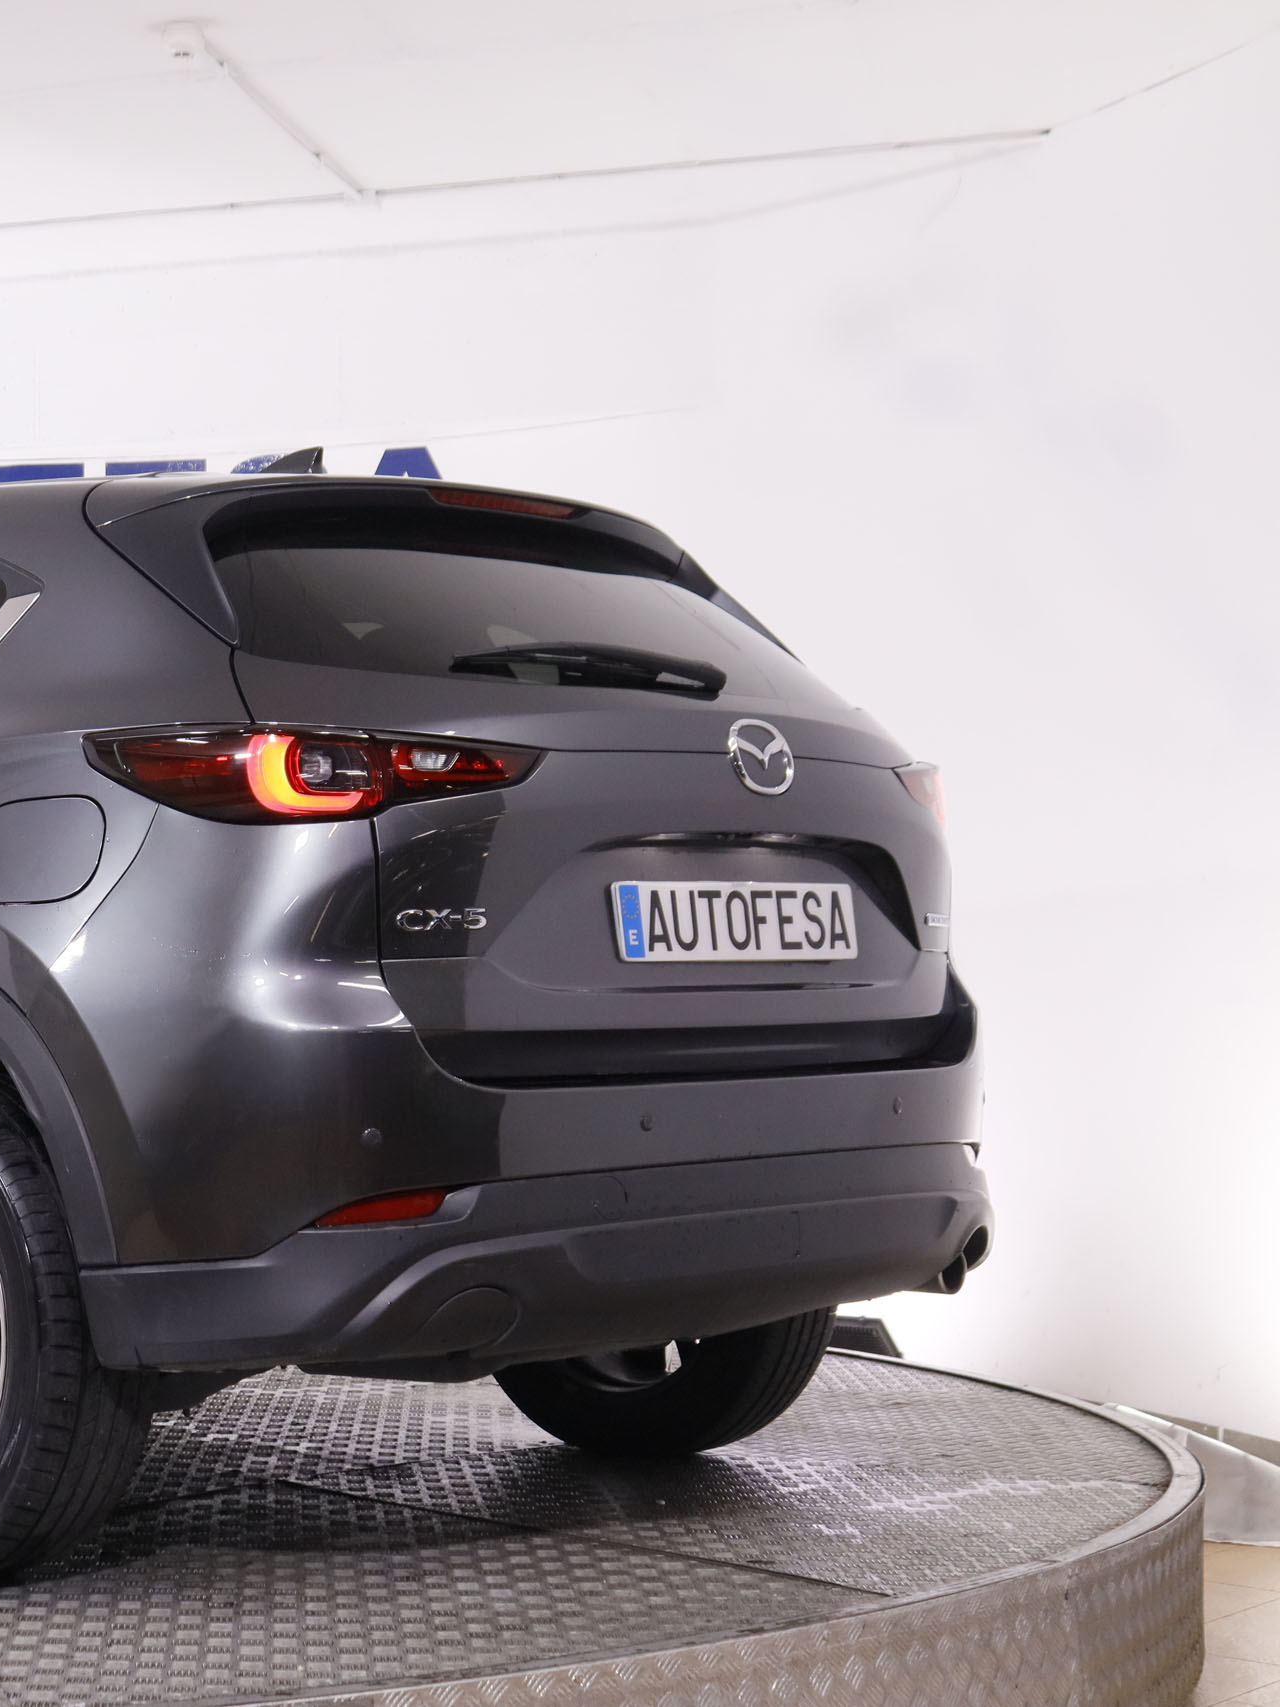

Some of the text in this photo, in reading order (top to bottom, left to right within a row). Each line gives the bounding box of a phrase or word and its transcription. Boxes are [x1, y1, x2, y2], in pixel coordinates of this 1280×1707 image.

[396, 908, 487, 931] CX-5
[648, 890, 851, 951] AUTOFESA
[628, 929, 639, 946] E
